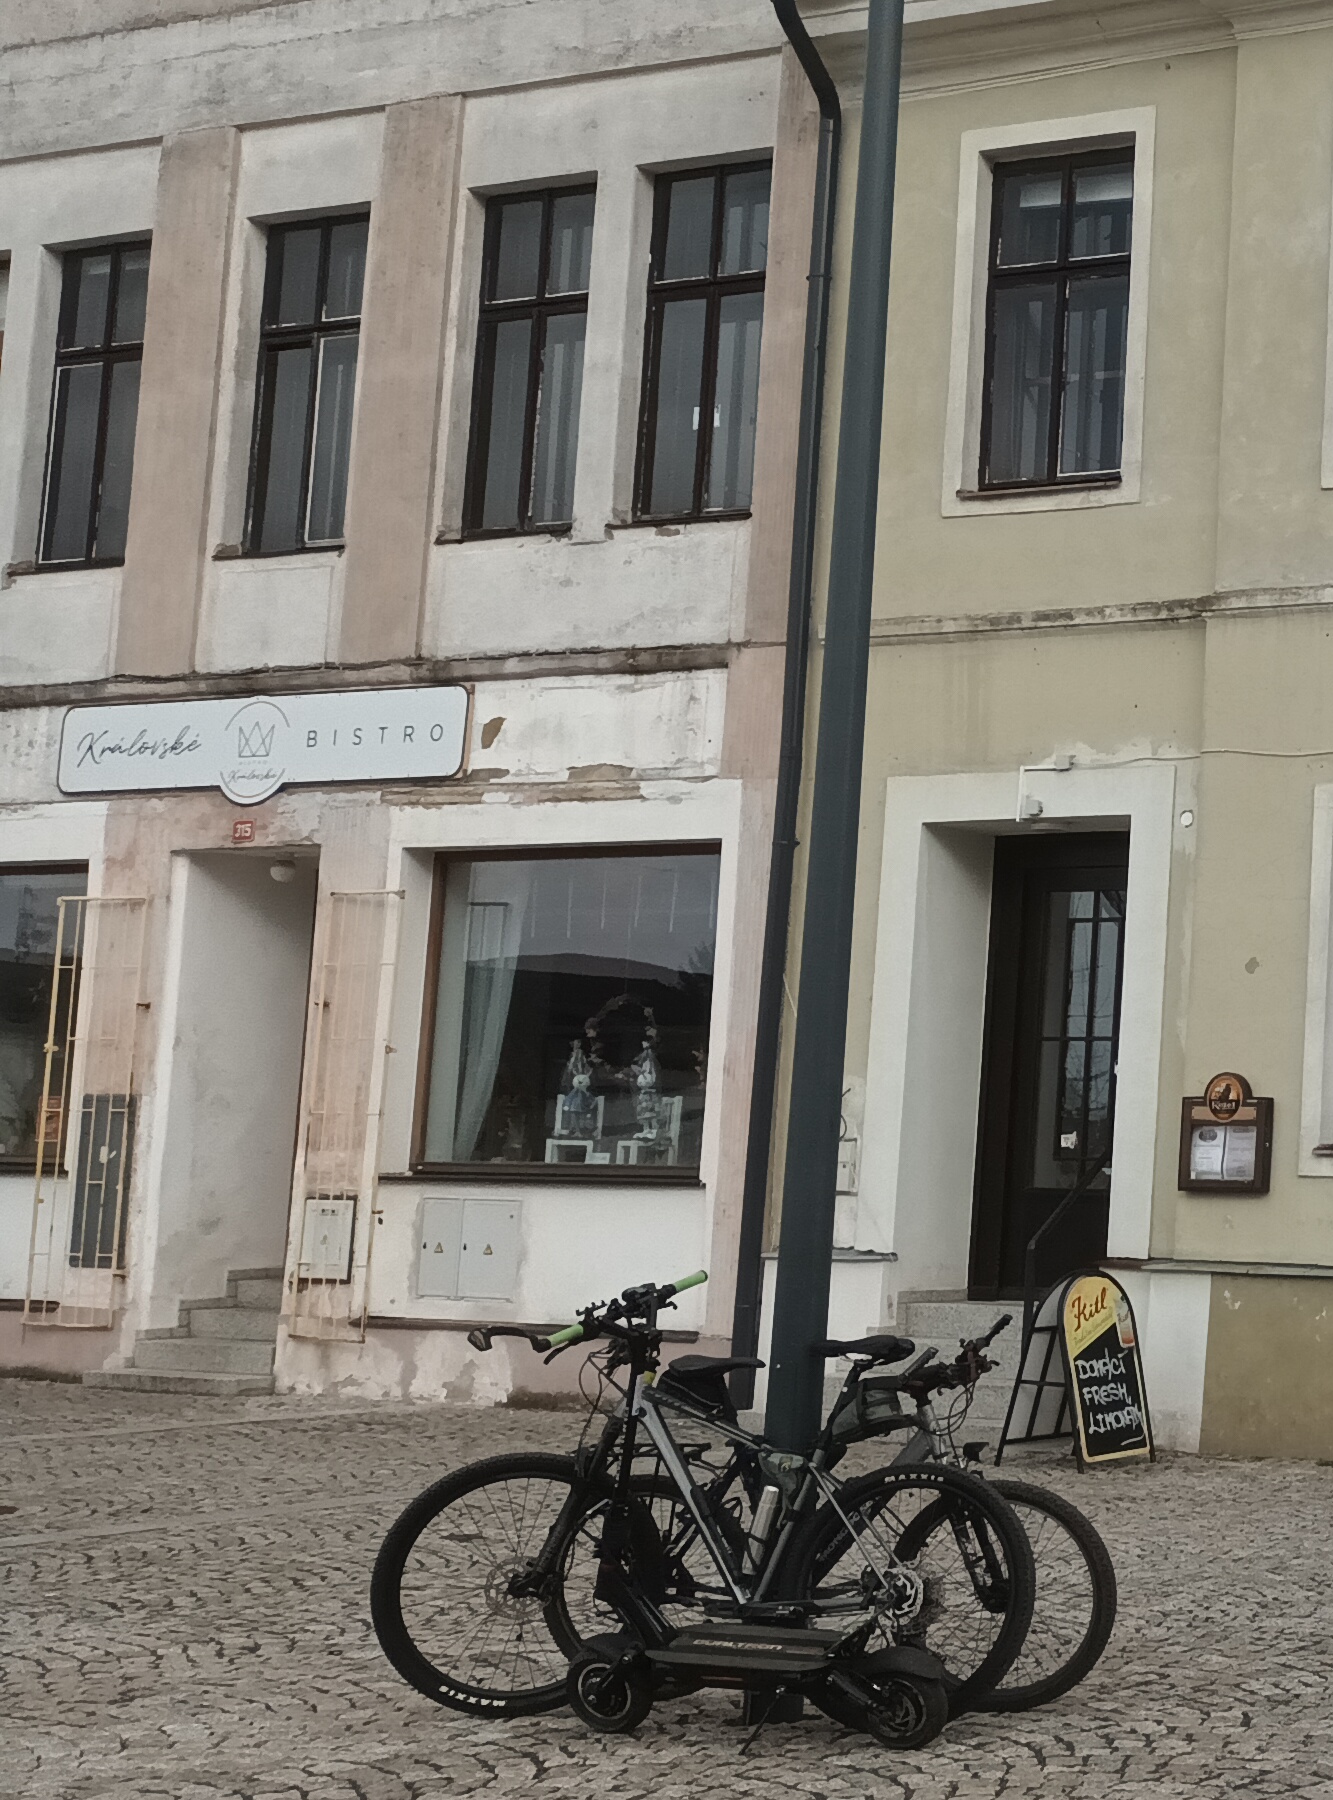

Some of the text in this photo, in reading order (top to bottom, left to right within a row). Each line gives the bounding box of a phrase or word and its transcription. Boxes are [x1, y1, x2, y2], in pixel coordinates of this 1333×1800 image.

[306, 723, 444, 748] BISTRO
[234, 823, 252, 838] 315
[1071, 1286, 1107, 1333] Kitl
